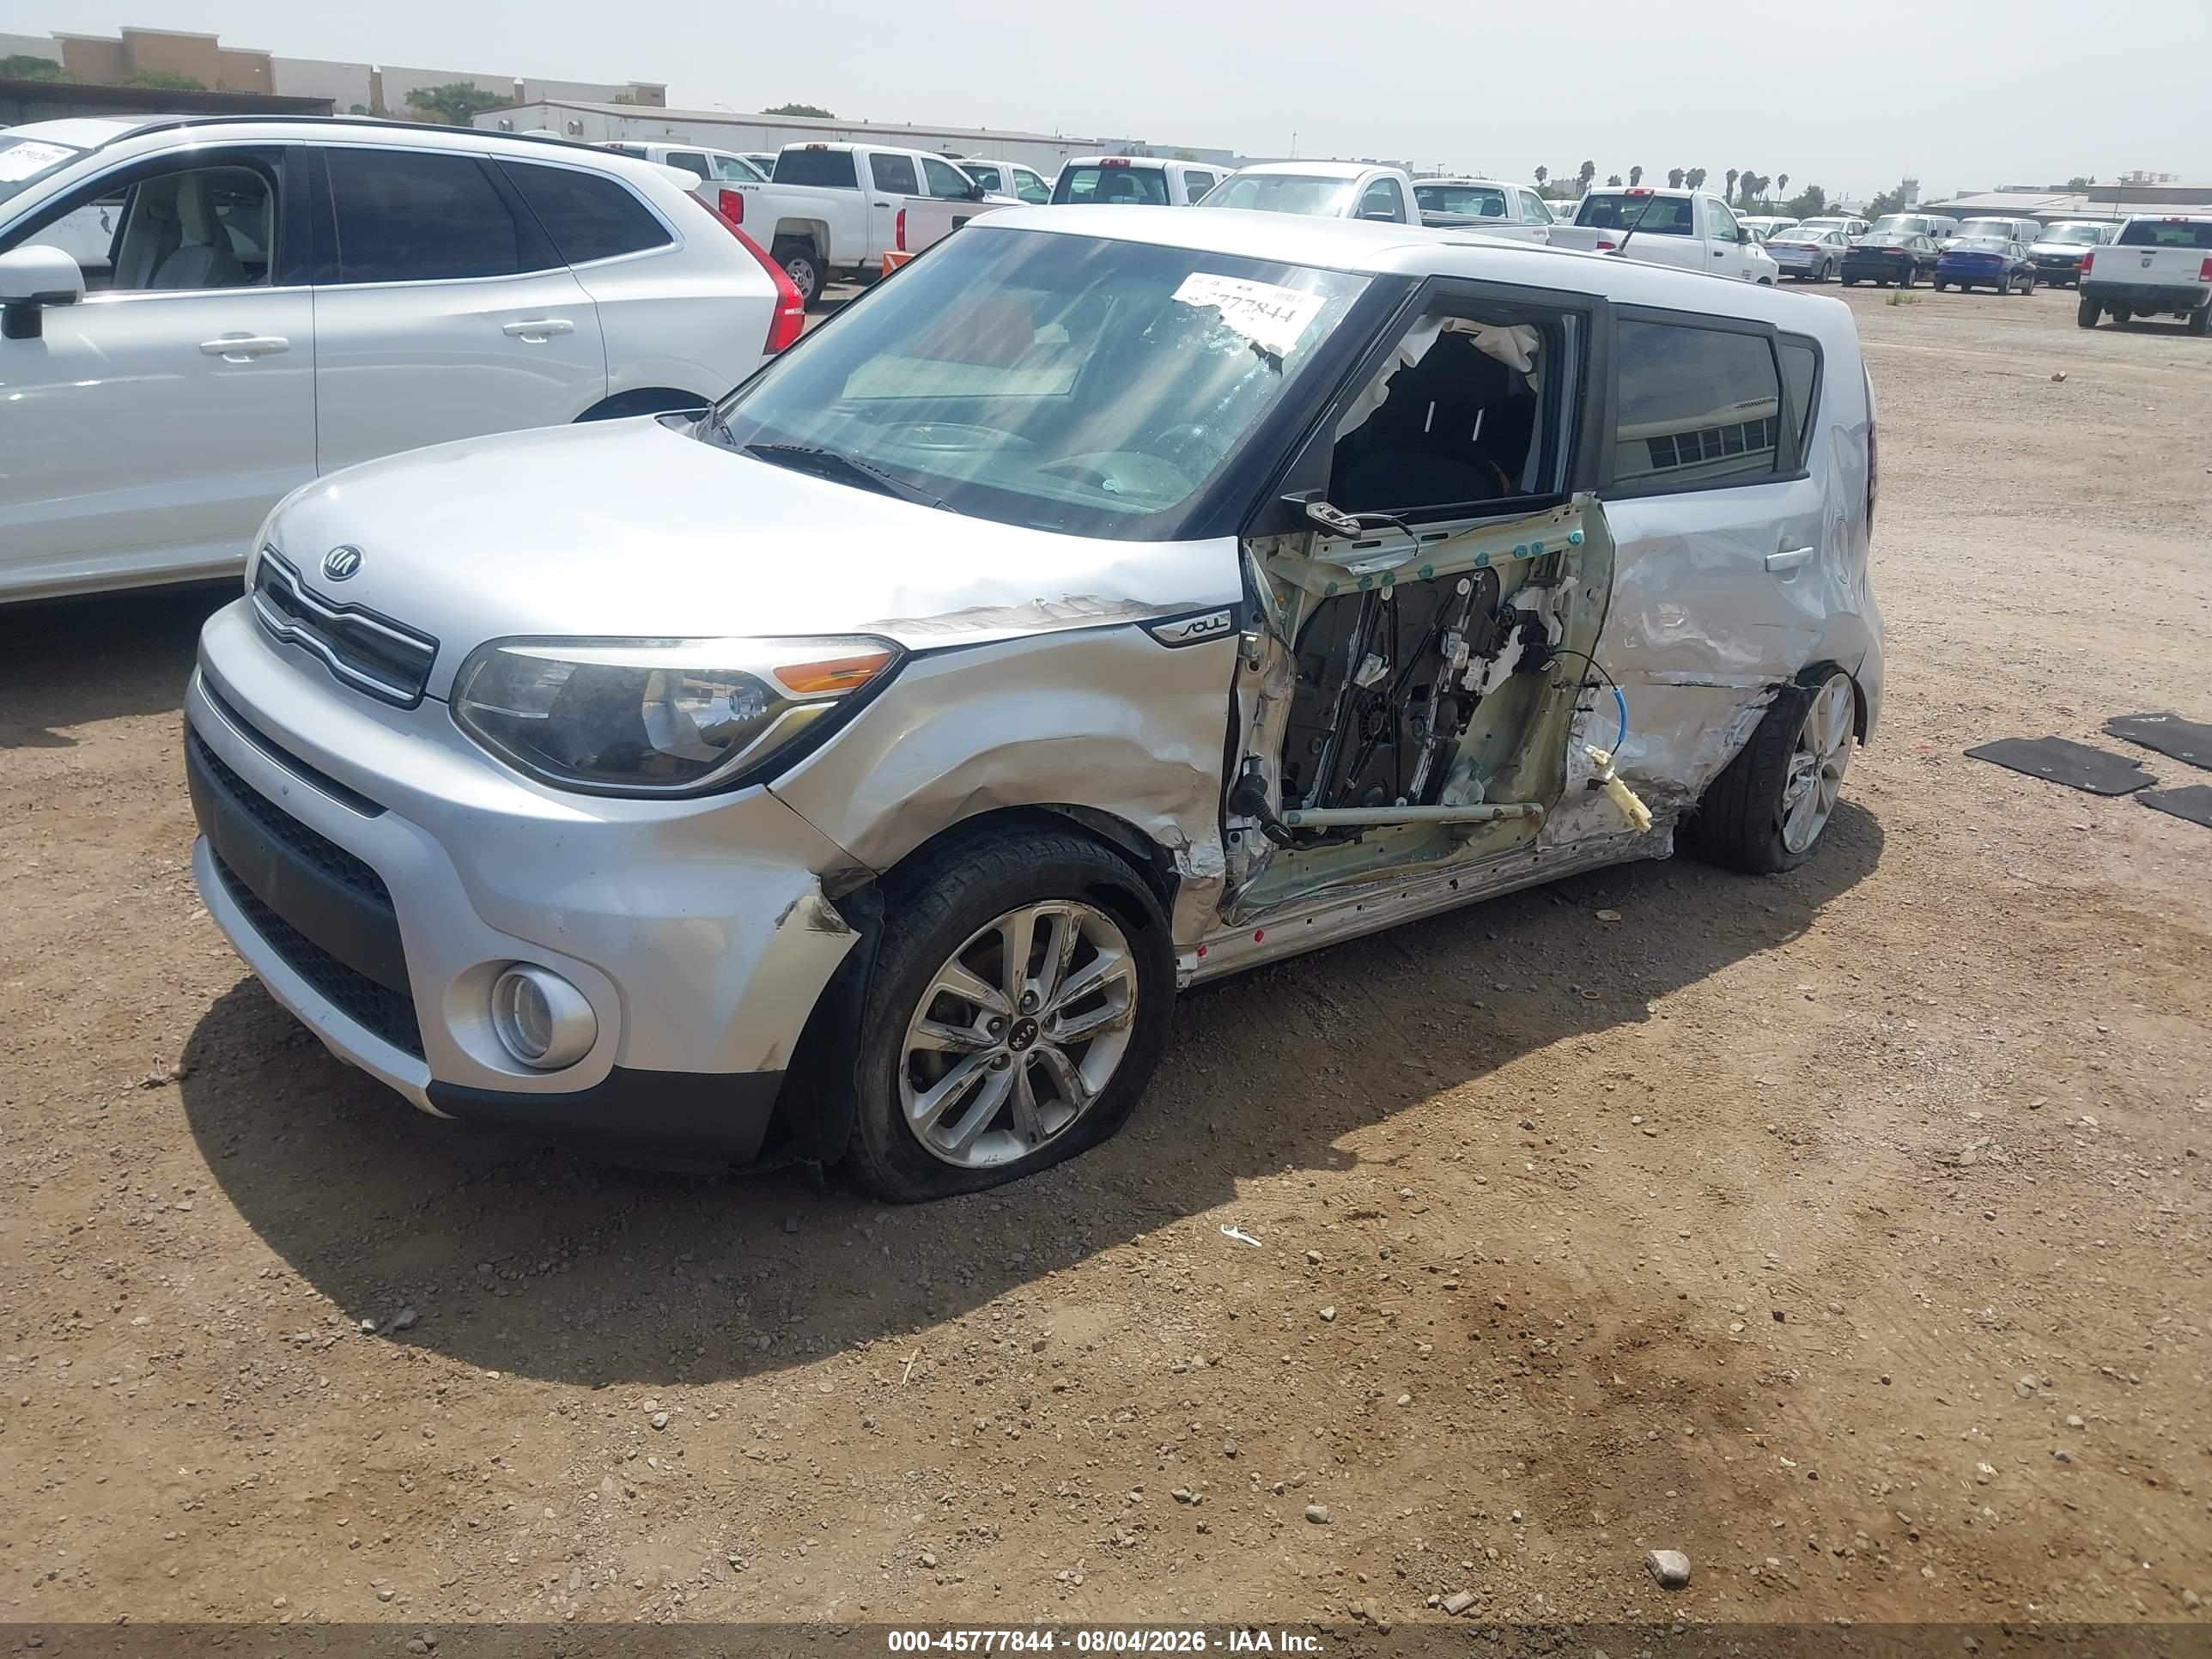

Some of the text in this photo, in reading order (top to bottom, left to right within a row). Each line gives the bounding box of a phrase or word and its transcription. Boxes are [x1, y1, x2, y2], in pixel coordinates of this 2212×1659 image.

[324, 547, 357, 575] KIA
[1179, 617, 1229, 637] SOUL
[1012, 1024, 1036, 1048] KIA
